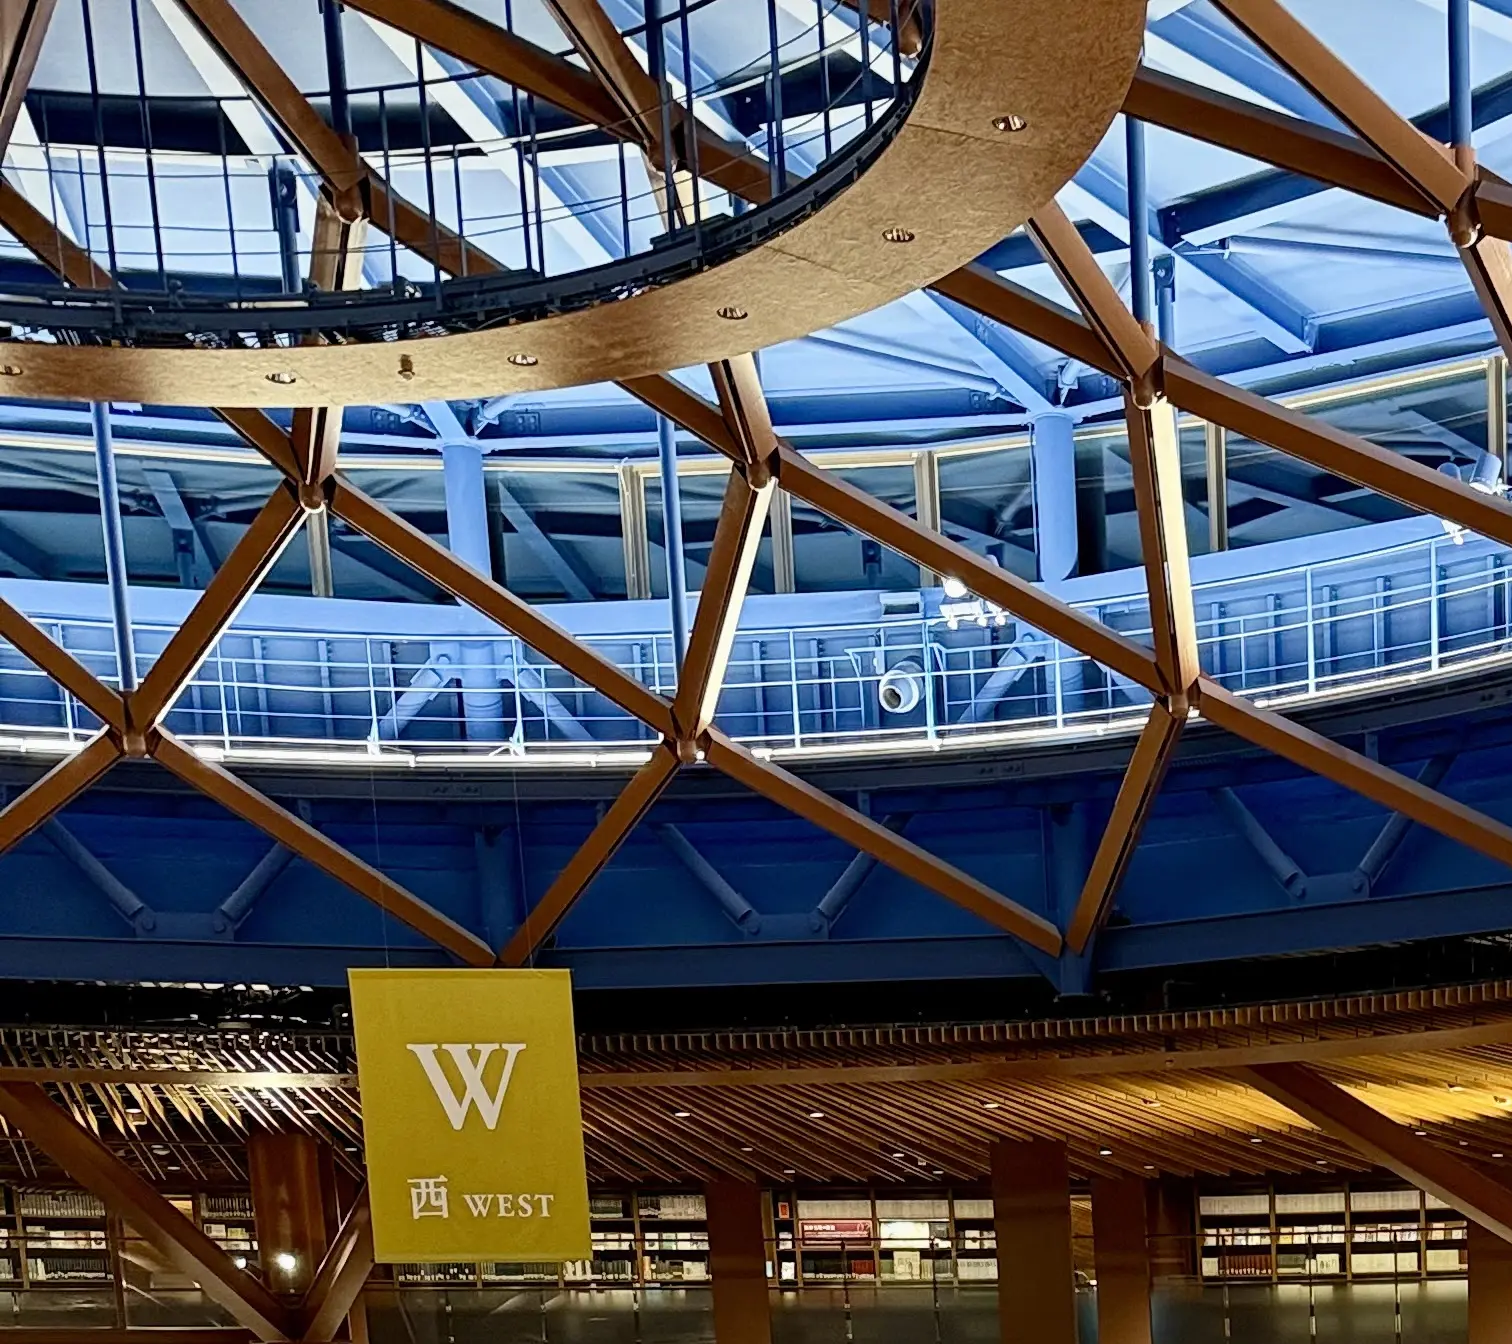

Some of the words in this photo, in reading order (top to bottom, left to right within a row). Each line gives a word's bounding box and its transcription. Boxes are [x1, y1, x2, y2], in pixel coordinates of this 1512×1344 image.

[406, 1042, 527, 1131] W
[406, 1174, 450, 1220] 西
[463, 1193, 555, 1219] WEST
